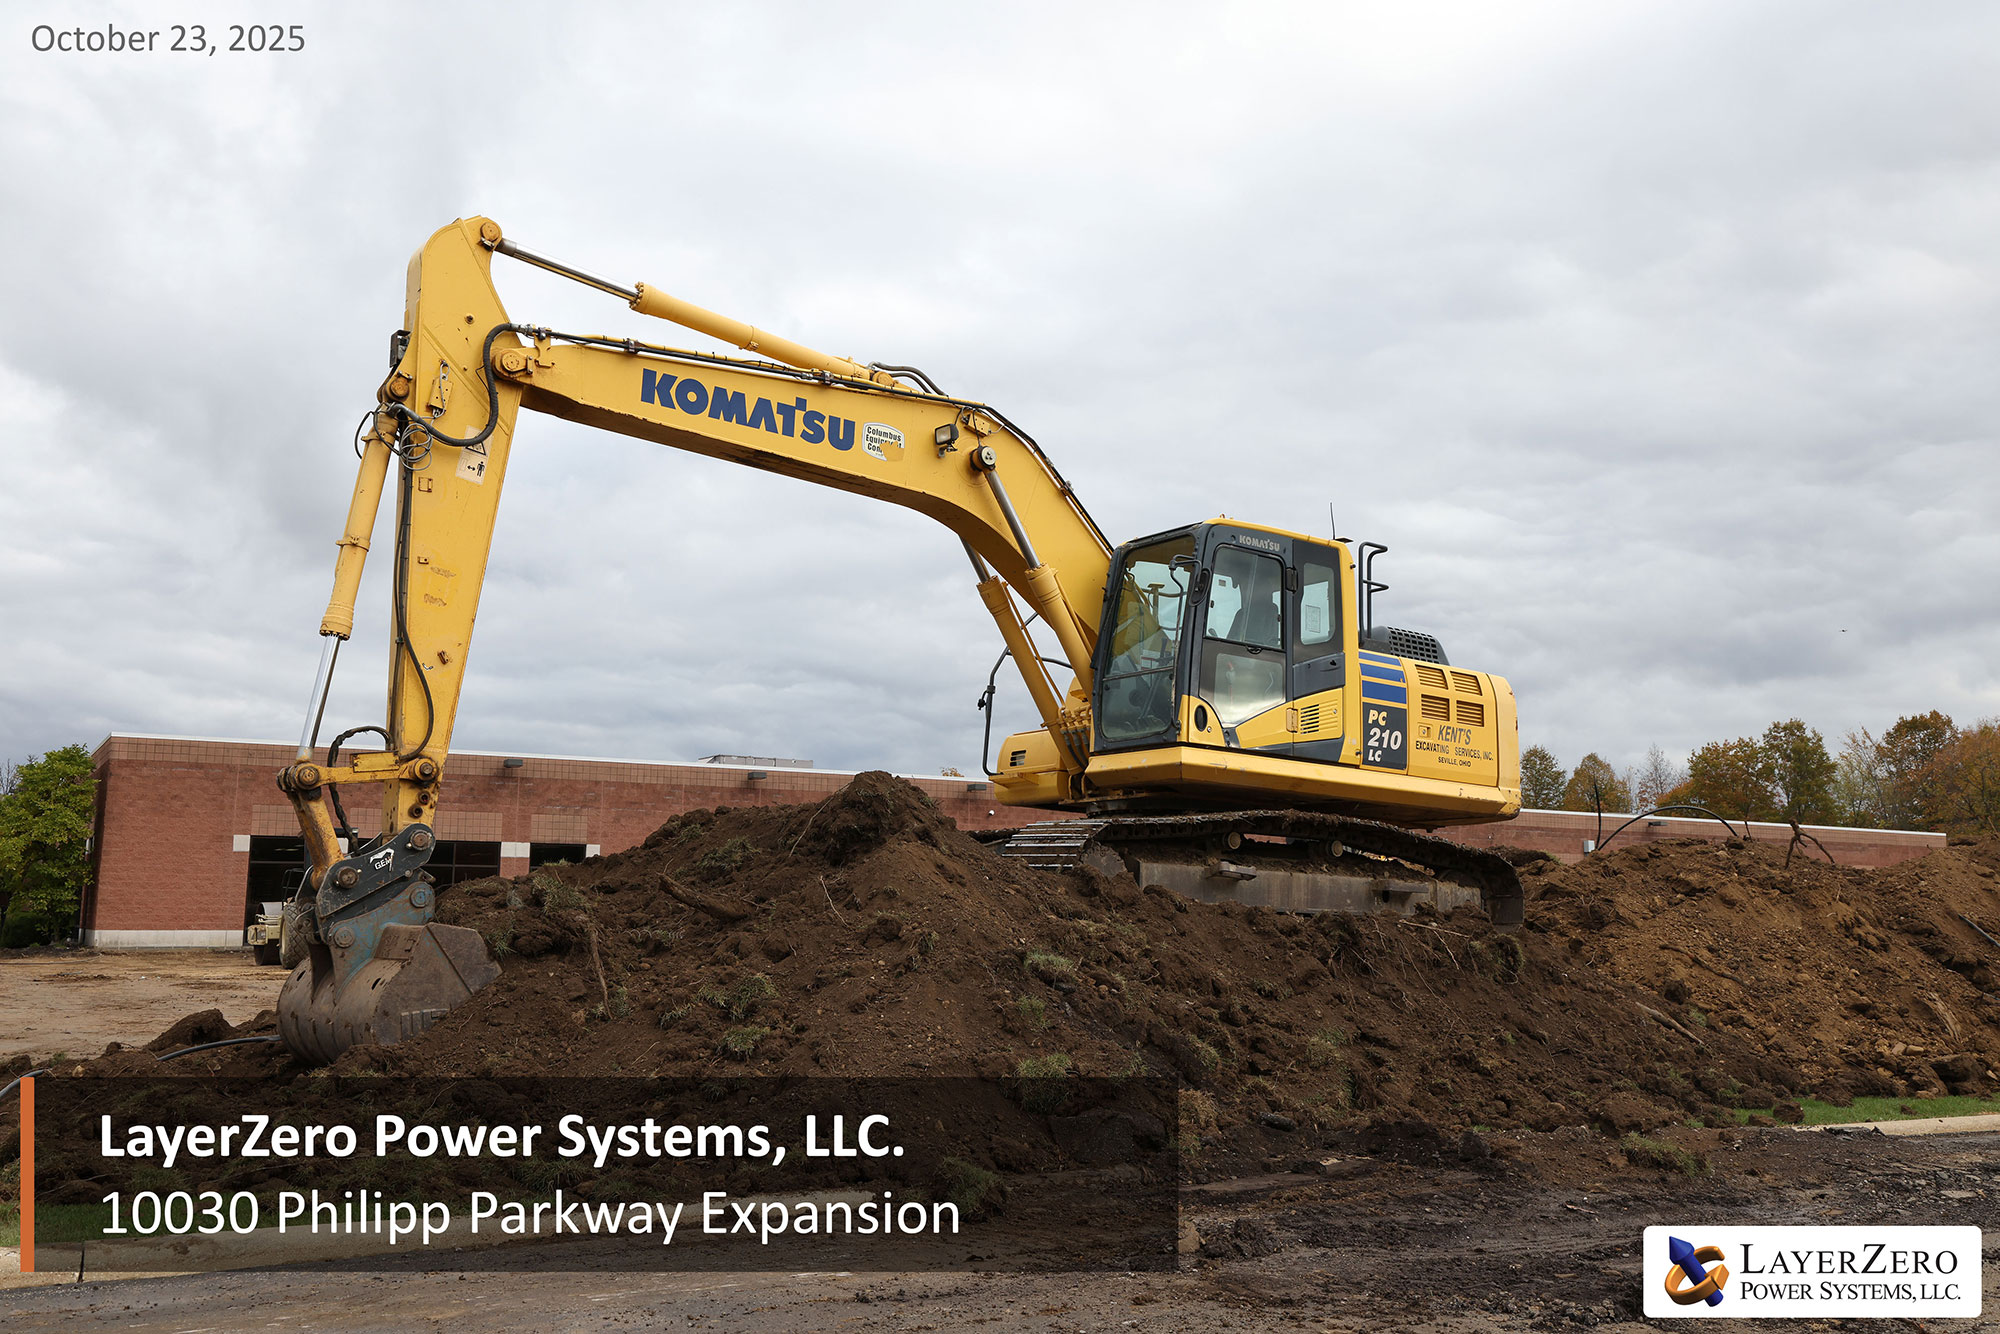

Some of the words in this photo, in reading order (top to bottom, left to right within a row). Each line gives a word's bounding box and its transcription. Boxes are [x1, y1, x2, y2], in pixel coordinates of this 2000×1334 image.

[641, 368, 856, 451] KOMATSU
[867, 426, 902, 442] Columbus
[1239, 534, 1280, 552] KOMATSU
[1368, 709, 1388, 726] PC
[1367, 727, 1402, 750] 210
[1438, 724, 1472, 745] KENT'S
[1367, 749, 1382, 762] LC
[1415, 740, 1450, 755] EXCAVATING
[1454, 746, 1483, 760] SERVICES,
[1483, 751, 1494, 761] INC.
[1458, 759, 1472, 767] OHIO
